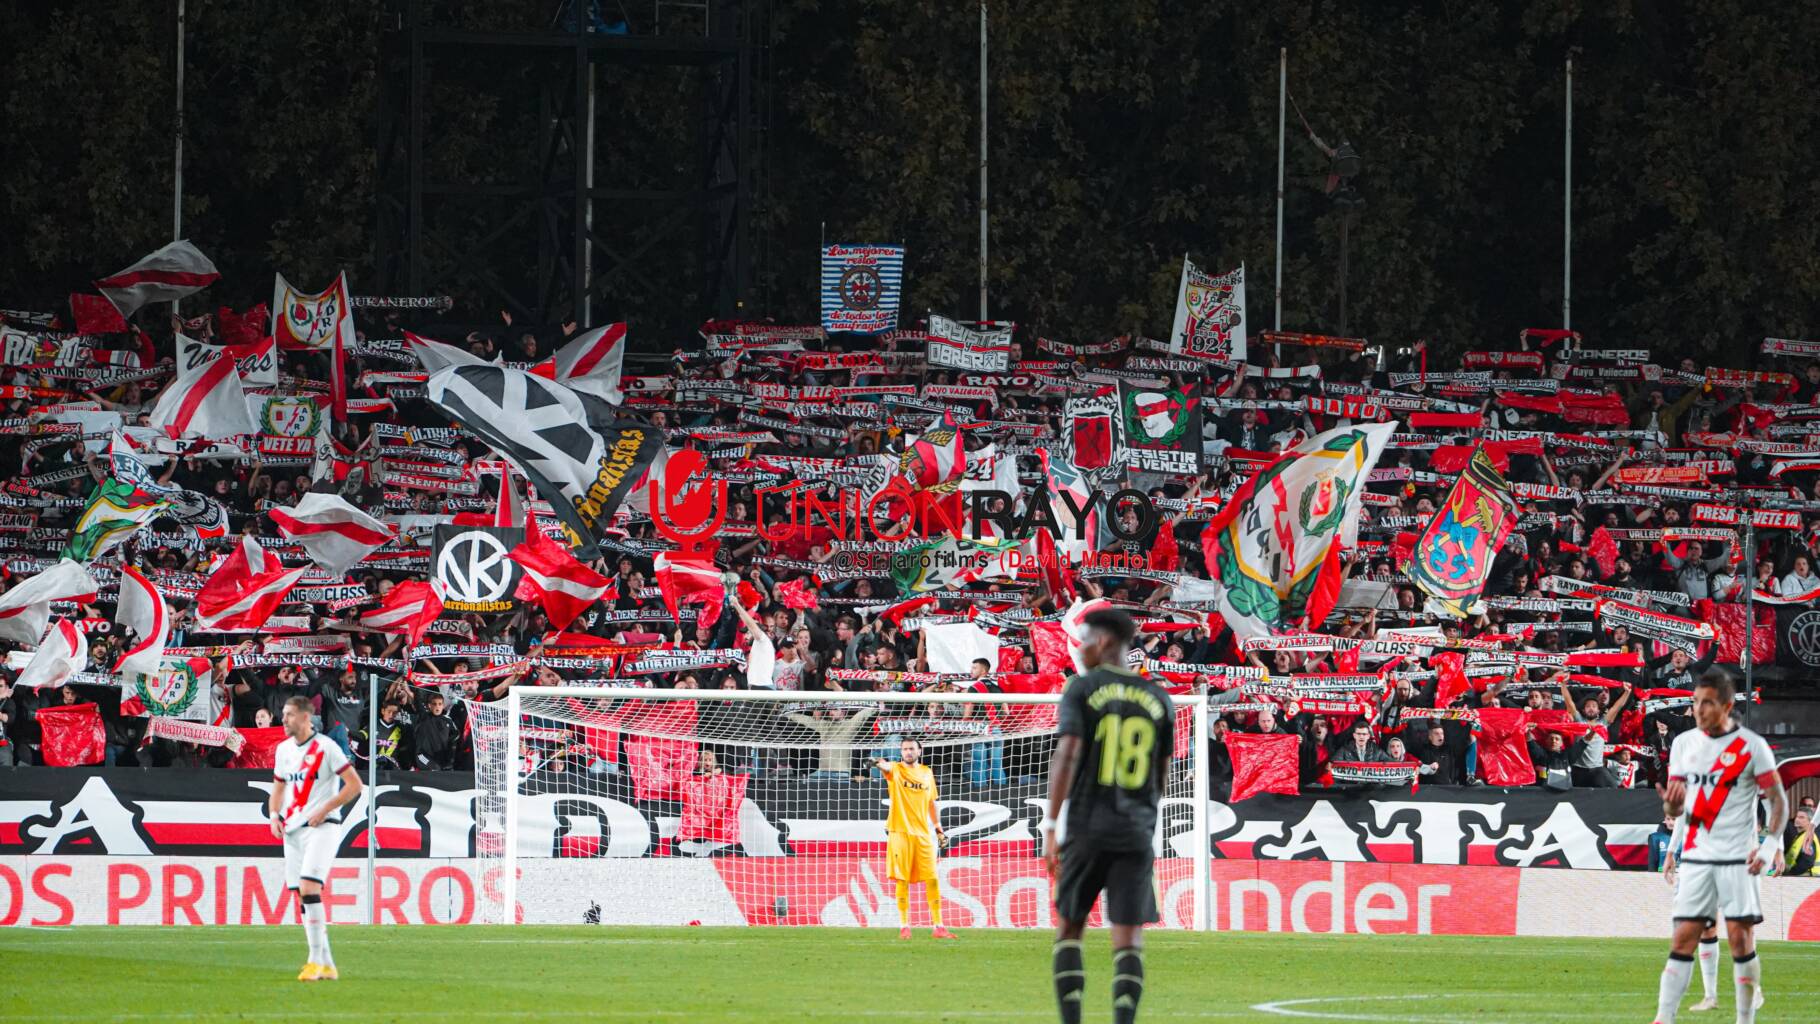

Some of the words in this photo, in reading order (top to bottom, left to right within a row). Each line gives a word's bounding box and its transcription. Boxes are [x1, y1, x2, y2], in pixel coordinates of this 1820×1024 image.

[1180, 333, 1234, 355] 1924
[928, 342, 1010, 372] OBREROS
[1023, 362, 1070, 370] VALLECANO
[1092, 367, 1156, 379] GIRONDINS
[967, 376, 1028, 386] RAYO
[1310, 397, 1377, 418] RAYO
[265, 438, 294, 453] VETE
[1142, 460, 1198, 474] VENCER
[1696, 505, 1735, 522] PRESA
[1752, 512, 1784, 527] VETE
[1784, 514, 1800, 527] YA
[324, 585, 367, 601] CLASS
[1557, 581, 1580, 591] RAYO
[1583, 585, 1633, 600] VALLECANO
[445, 600, 513, 612] arrionalistas
[76, 620, 112, 634] AYO
[1616, 607, 1641, 621] RAYO
[1643, 614, 1696, 632] VALLECANO
[1375, 642, 1416, 654] CLASS
[1297, 676, 1321, 687] RAYO
[1323, 675, 1379, 687] VALLECANO
[1094, 713, 1156, 789] 18
[1361, 766, 1414, 777] VALLECANO
[106, 863, 525, 927] PRIMEROS
